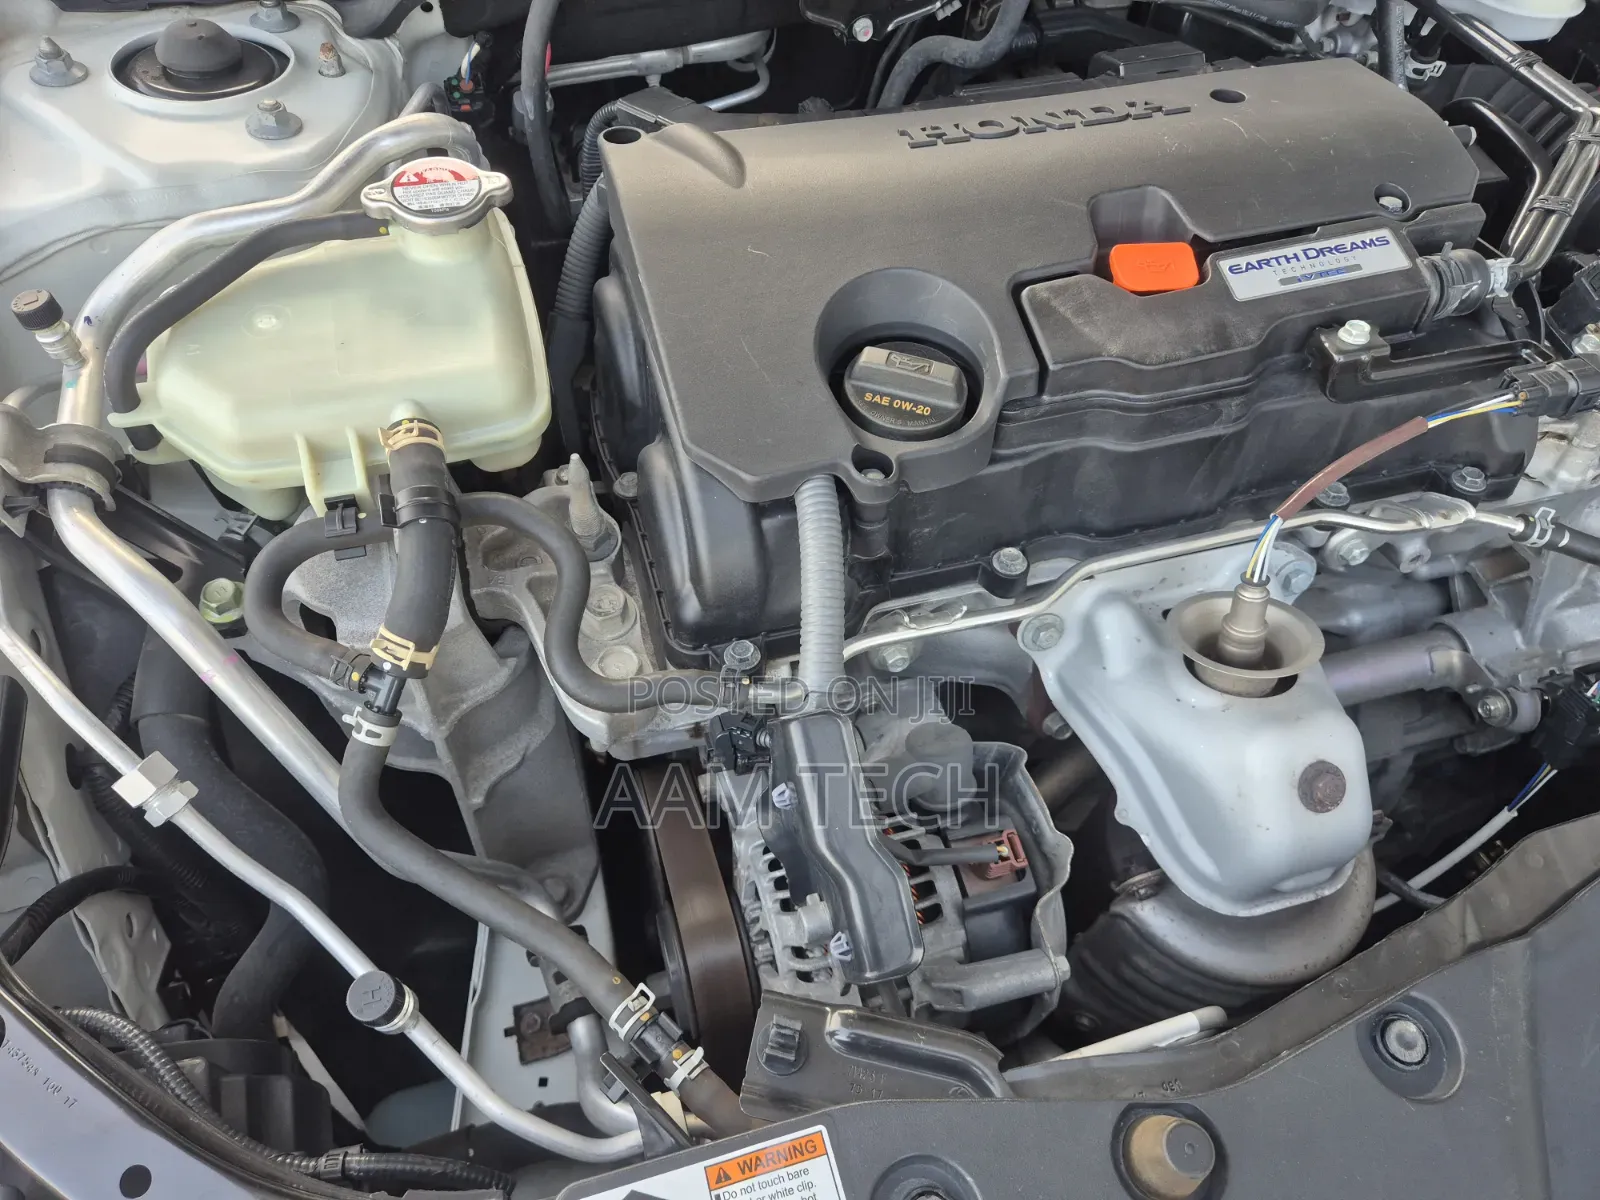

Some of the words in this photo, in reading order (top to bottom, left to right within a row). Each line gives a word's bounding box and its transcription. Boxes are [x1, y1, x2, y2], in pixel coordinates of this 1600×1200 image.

[897, 101, 1191, 149] HONDA
[1228, 252, 1301, 275] EARTH
[1301, 235, 1390, 261] DREAMS
[1273, 255, 1358, 276] TECHNOLOGY
[864, 392, 891, 406] SAE
[893, 399, 931, 416] 0W-20
[736, 1139, 818, 1175] WARNING
[722, 1190, 738, 1200] Do
[739, 1183, 756, 1196] not
[757, 1173, 785, 1190] touch
[786, 1167, 810, 1182] bare
[768, 1186, 794, 1200] white
[796, 1180, 817, 1192] clip.
